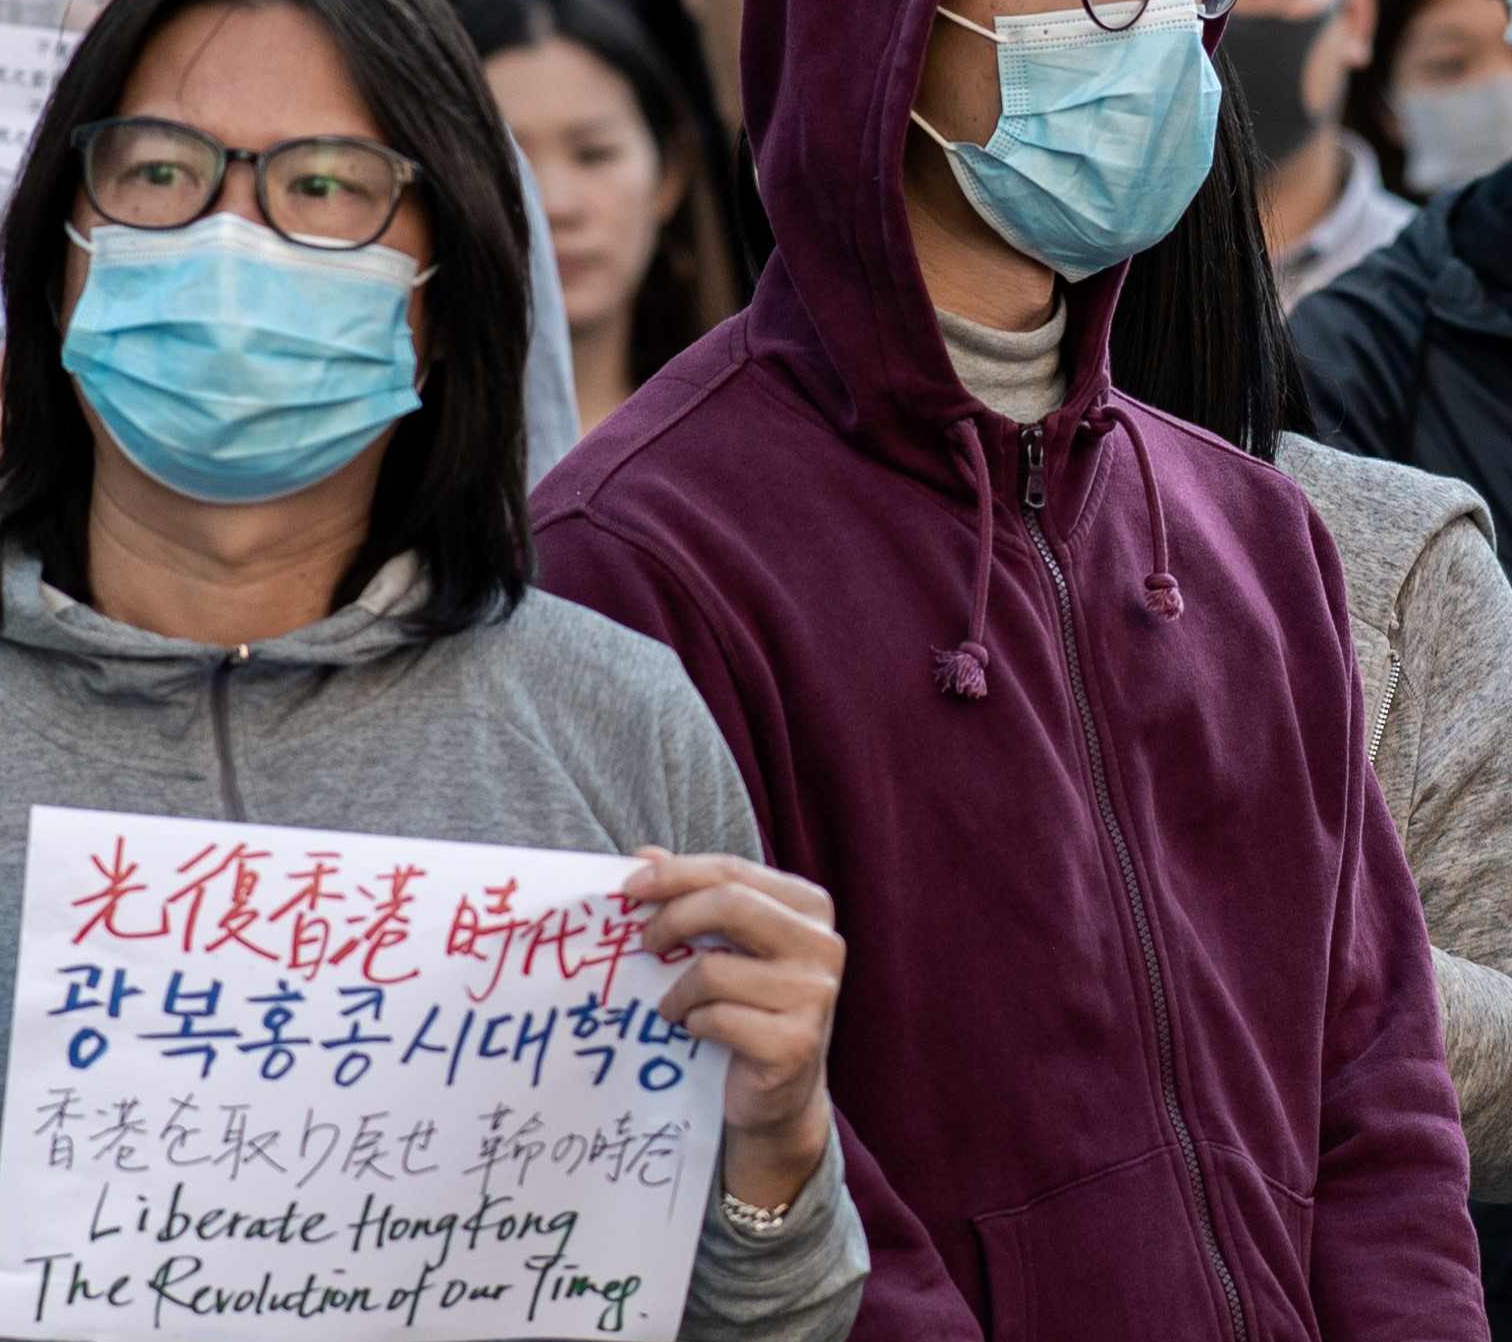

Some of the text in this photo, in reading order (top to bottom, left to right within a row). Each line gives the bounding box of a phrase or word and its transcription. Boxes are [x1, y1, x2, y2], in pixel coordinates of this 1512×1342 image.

[446, 878, 733, 1006] 時代革
[89, 1184, 336, 1246] Liberate
[23, 1255, 135, 1329] The
[147, 1258, 375, 1329] Revolution
[385, 1271, 435, 1323] of
